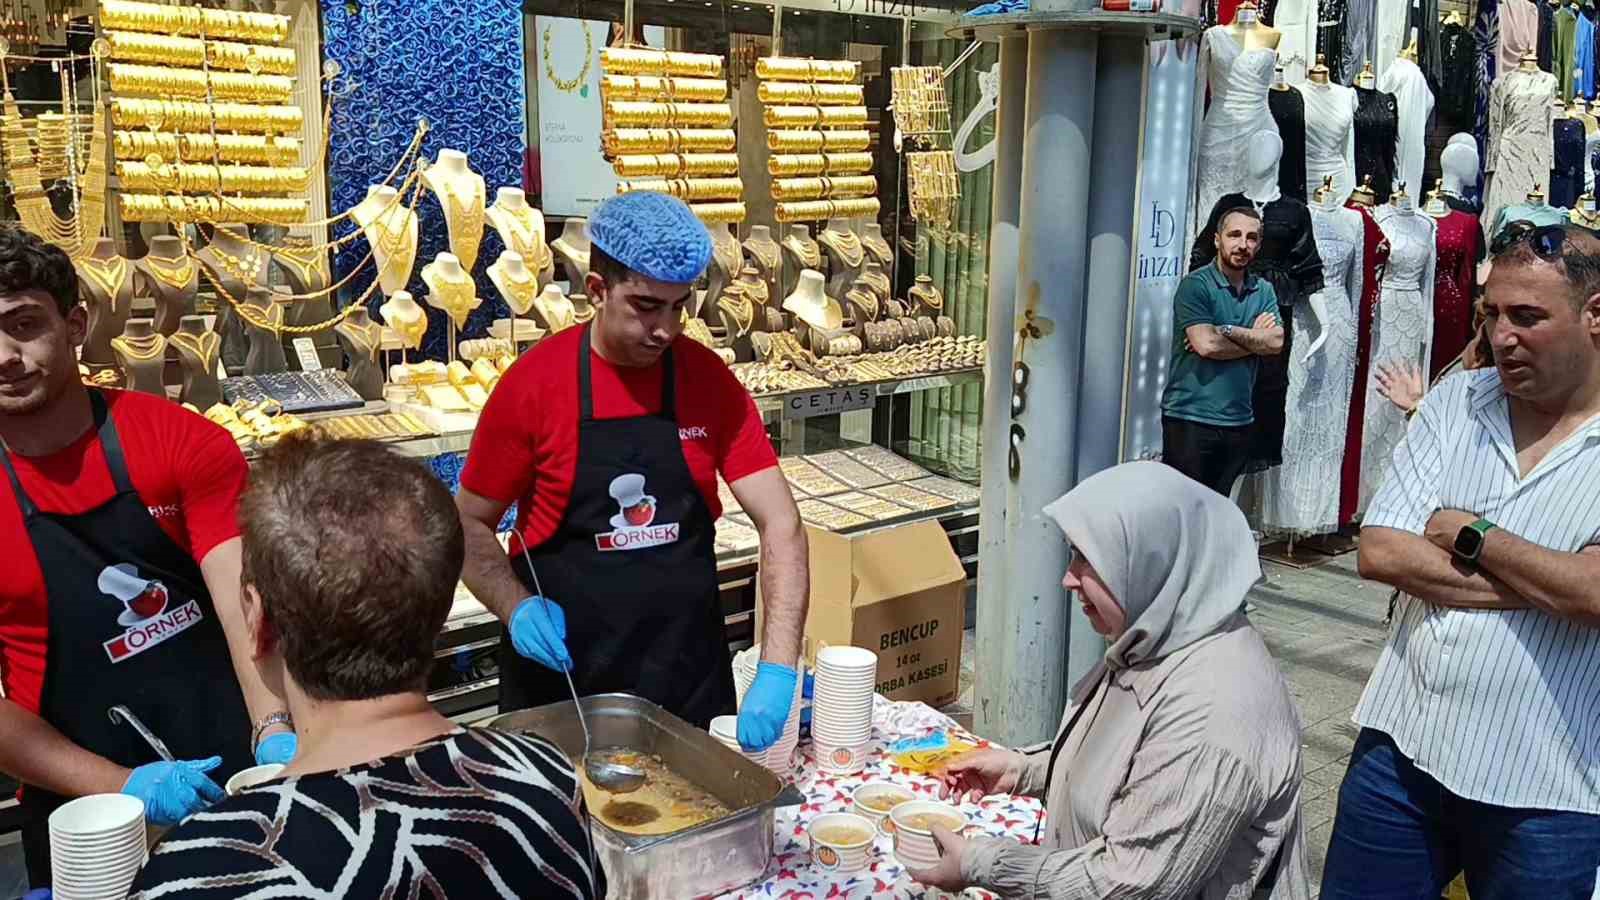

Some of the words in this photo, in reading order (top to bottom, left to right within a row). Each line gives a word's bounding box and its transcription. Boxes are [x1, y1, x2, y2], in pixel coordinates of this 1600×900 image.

[127, 602, 200, 648] ÖRNEK
[880, 619, 939, 650] BENCUP
[874, 676, 905, 695] ORBA
[908, 658, 948, 685] KASESİ
